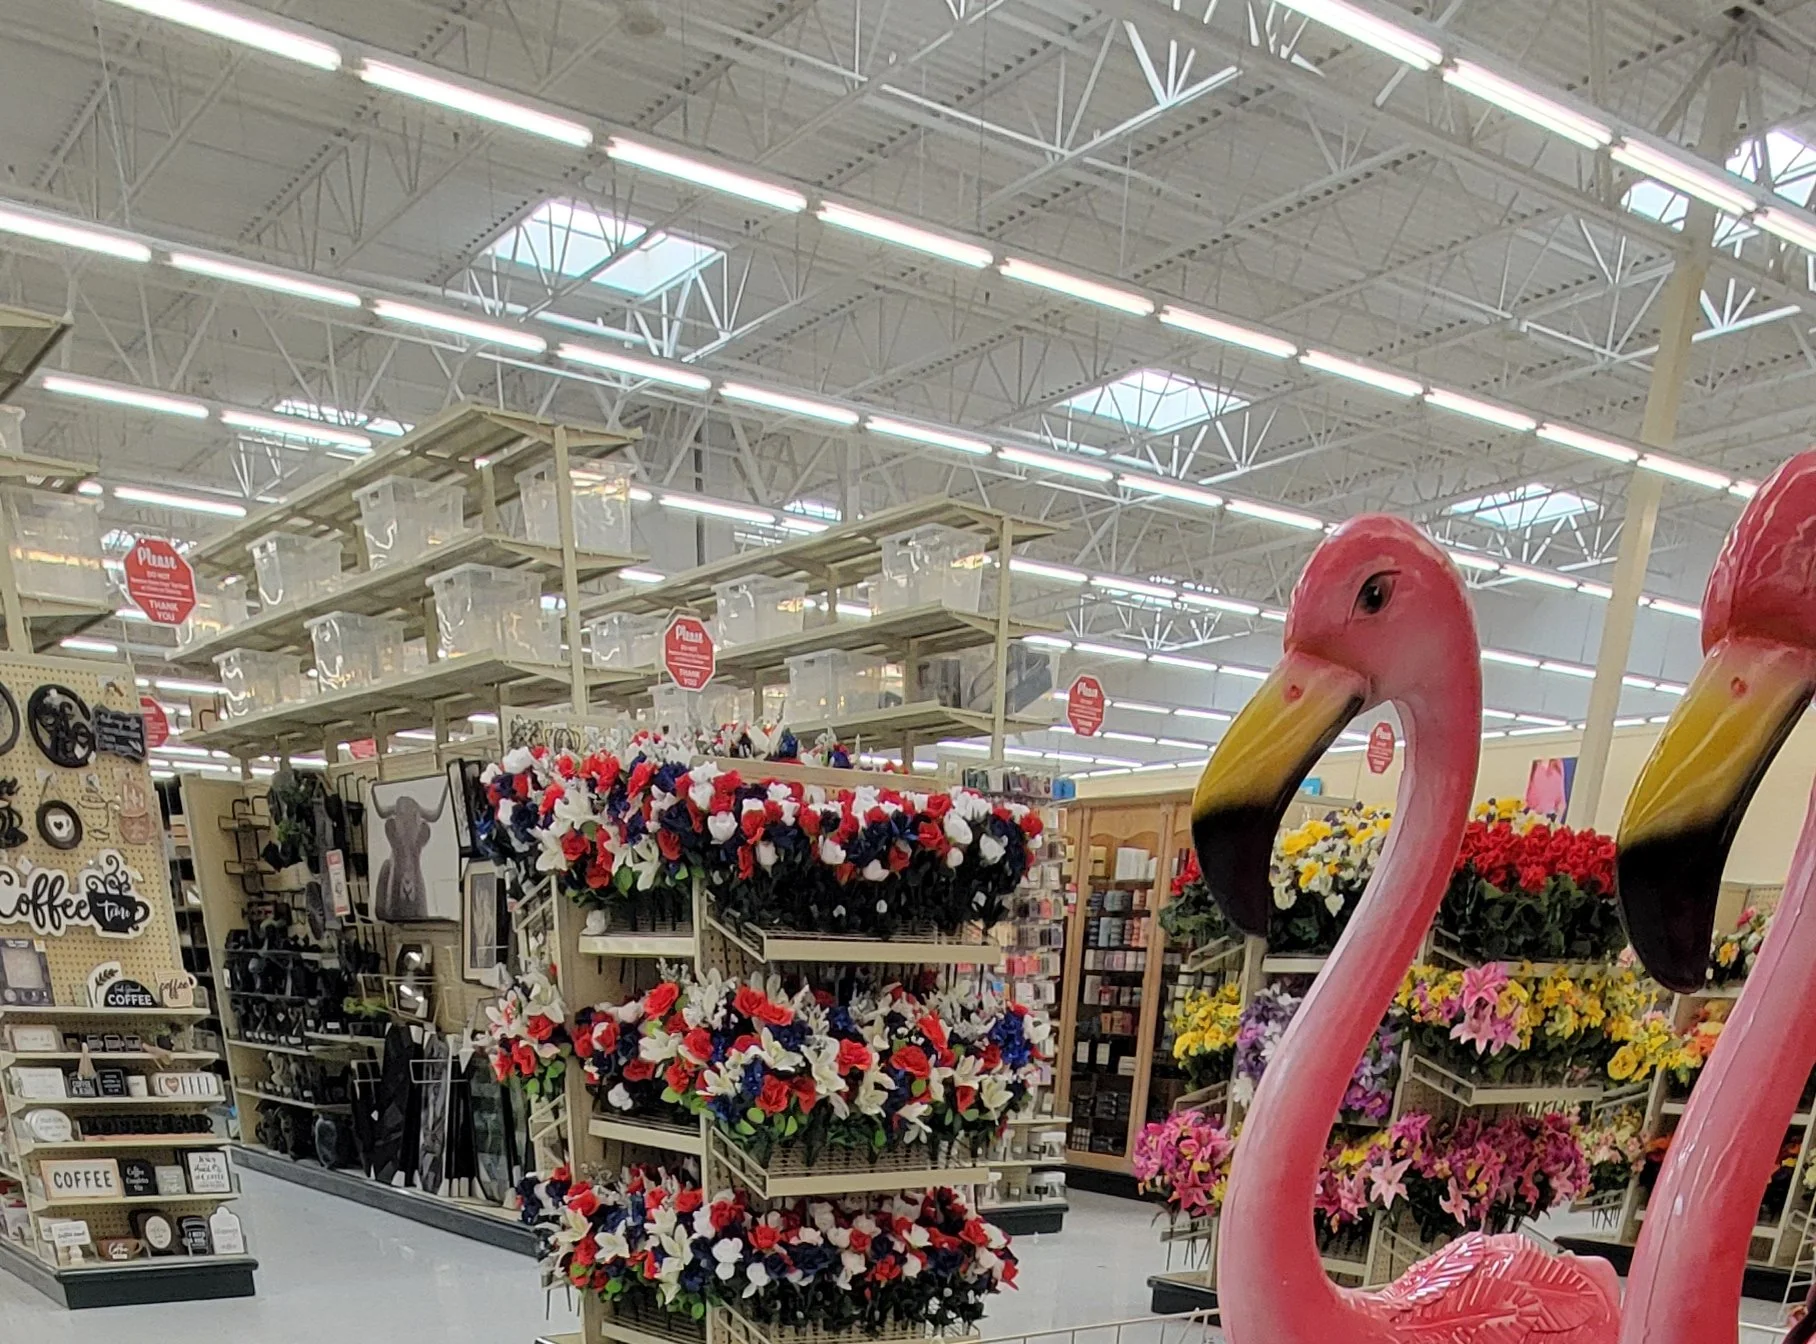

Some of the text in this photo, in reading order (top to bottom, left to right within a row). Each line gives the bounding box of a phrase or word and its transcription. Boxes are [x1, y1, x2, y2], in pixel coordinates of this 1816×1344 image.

[148, 599, 179, 612] THANK
[156, 611, 175, 621] YOU
[160, 979, 189, 1000] coffee
[107, 994, 152, 1006] COFFEE
[53, 1170, 113, 1189] COFFEE
